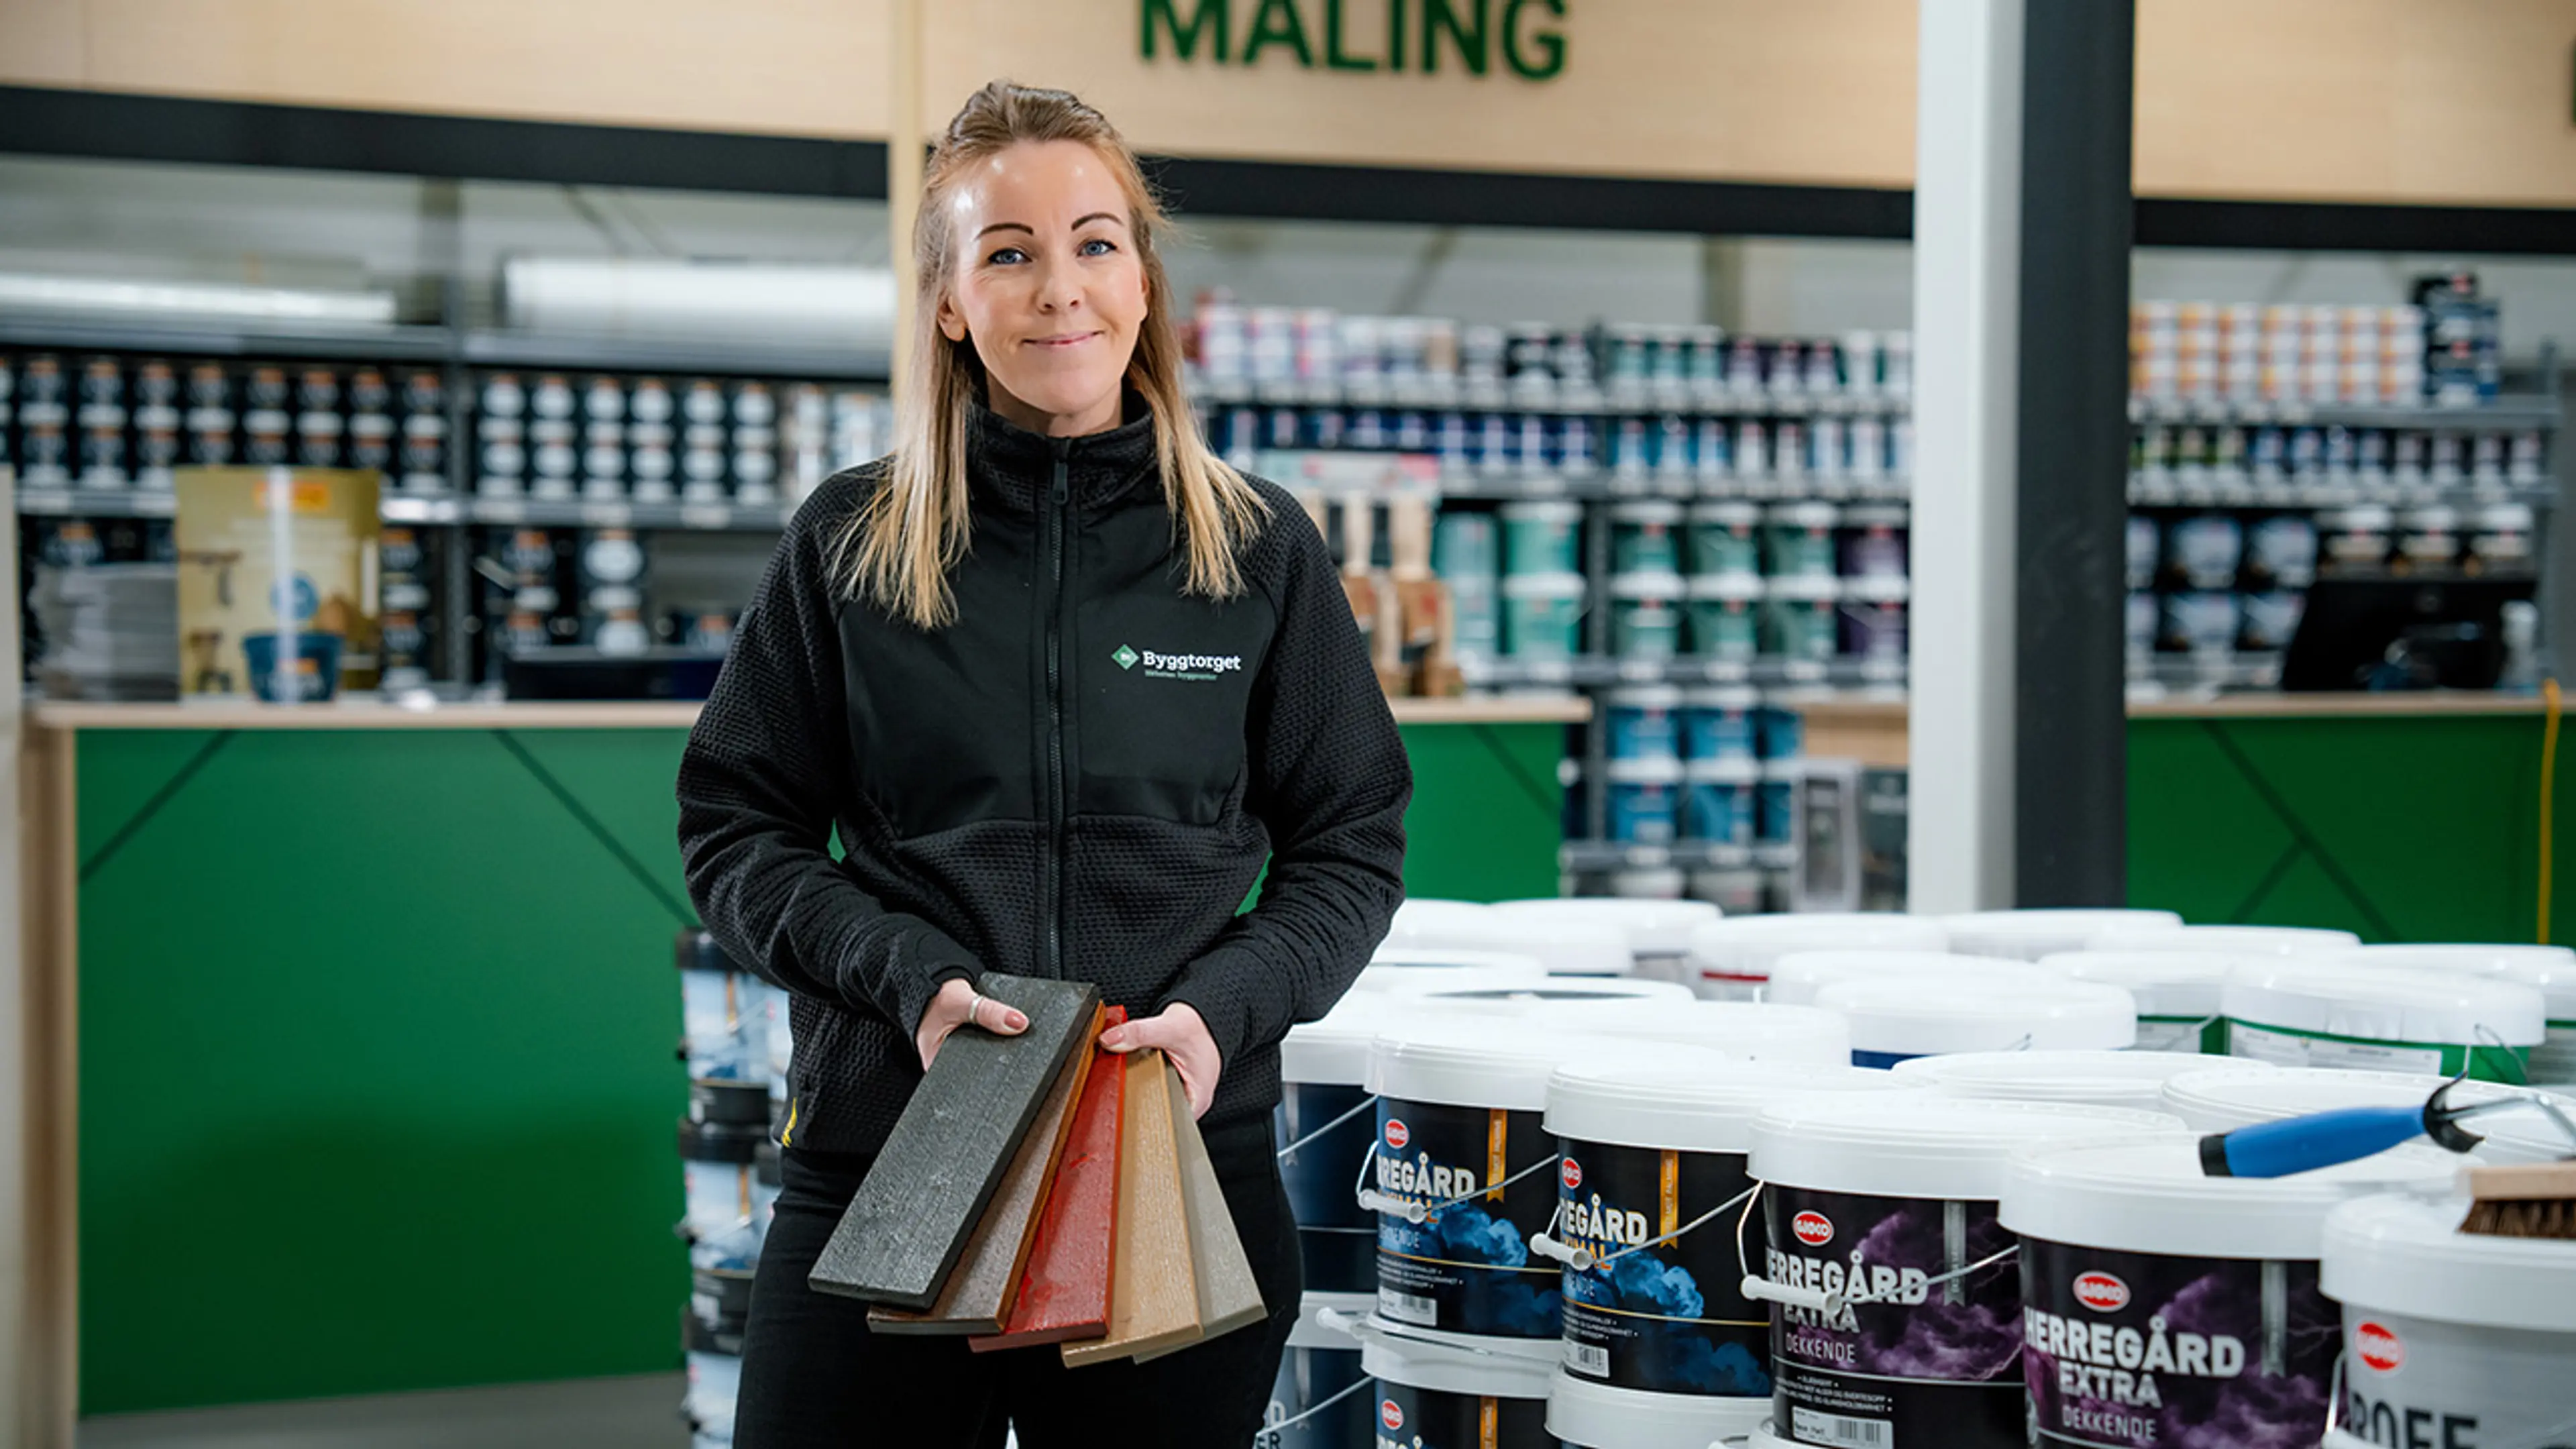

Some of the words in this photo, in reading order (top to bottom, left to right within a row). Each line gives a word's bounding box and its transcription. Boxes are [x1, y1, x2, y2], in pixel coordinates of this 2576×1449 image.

[1140, 0, 1567, 80] MALING
[1142, 650, 1241, 673] Byggtorget
[1786, 1332, 1856, 1364] DEKKENDE
[2024, 1305, 2245, 1378] HERREGÅRD
[2059, 1360, 2163, 1409] EXTRA
[2061, 1404, 2157, 1442] DEKKENDE
